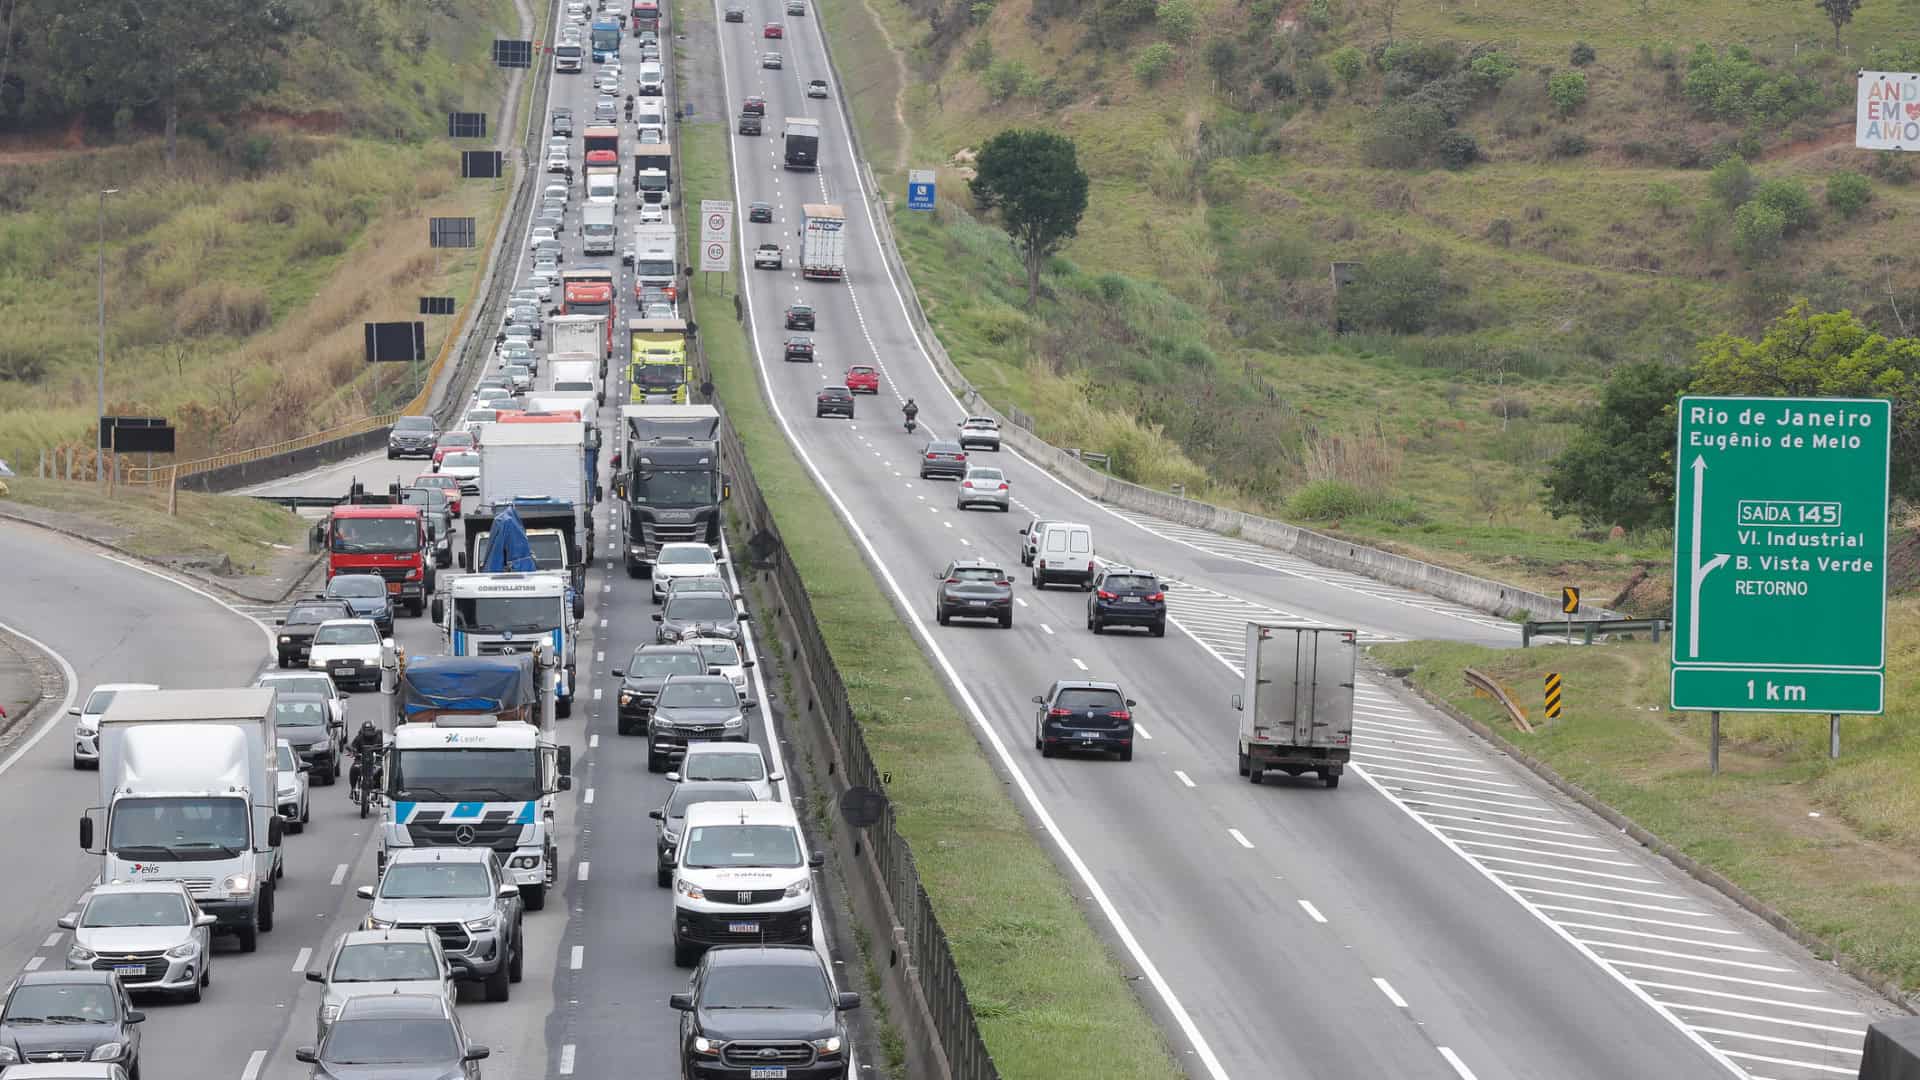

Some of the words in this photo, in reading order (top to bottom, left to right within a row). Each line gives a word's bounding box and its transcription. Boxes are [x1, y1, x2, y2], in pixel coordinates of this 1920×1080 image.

[1868, 101, 1901, 121] EM
[1690, 406, 1728, 425] Rio
[1739, 408, 1765, 425] de
[1776, 408, 1872, 427] Janeiro
[1690, 431, 1772, 450] Eugênio
[1780, 433, 1804, 448] de
[1812, 433, 1861, 449] Melo
[1742, 502, 1791, 521] SAÍDA
[1798, 505, 1837, 523] 145
[1767, 531, 1864, 547] Industrial
[1735, 556, 1752, 570] B.
[1759, 556, 1810, 571] Vista
[1817, 556, 1873, 572] Verde
[1735, 580, 1808, 596] RETORNO
[1746, 680, 1755, 700] 1
[1766, 680, 1806, 701] km
[737, 891, 752, 904] FIAT
